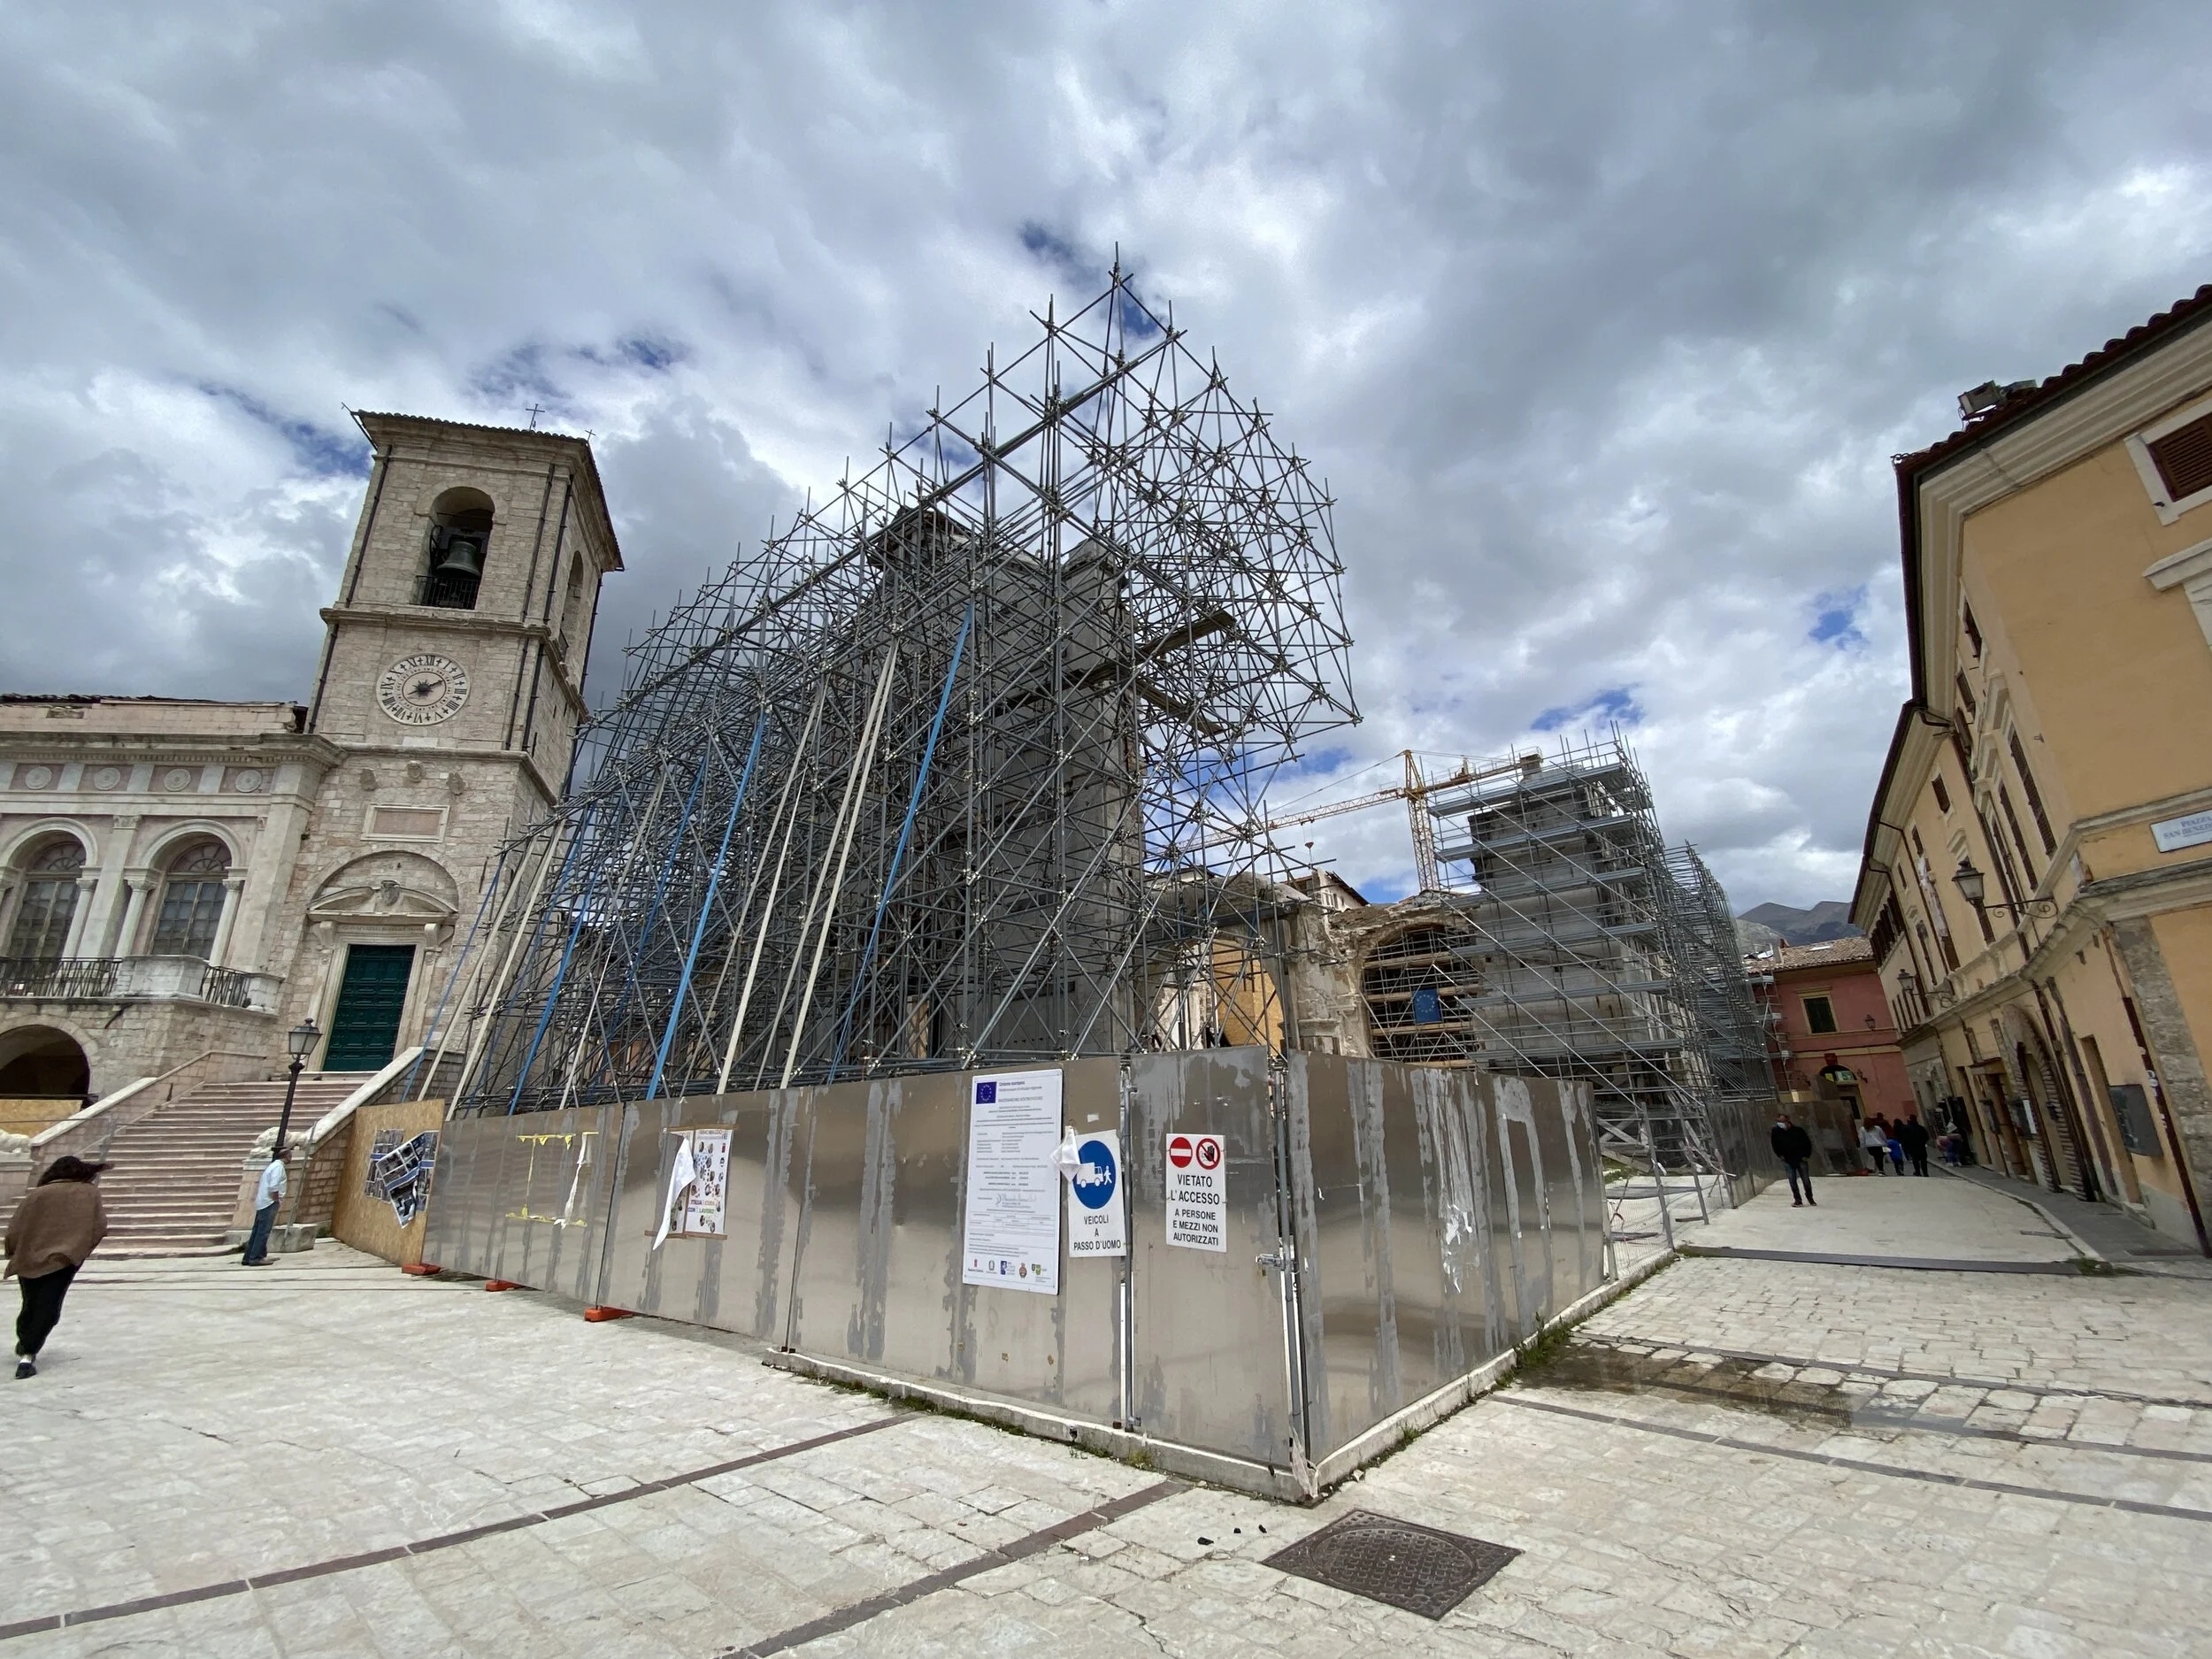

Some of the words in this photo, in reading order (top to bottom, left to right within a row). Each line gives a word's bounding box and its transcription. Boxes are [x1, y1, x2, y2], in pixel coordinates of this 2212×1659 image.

[426, 655, 435, 665] XII
[446, 700, 459, 710] IIII
[413, 713, 423, 723] VI
[1178, 1173, 1212, 1187] VIETATO
[1084, 1214, 1110, 1225] VEICOLI
[1182, 1209, 1216, 1220] PERSONE
[1094, 1228, 1099, 1237] A
[1179, 1221, 1201, 1231] MEZZI
[1202, 1224, 1218, 1233] NON
[1173, 1233, 1218, 1246] AUTORIZZATI
[1073, 1240, 1094, 1251] PASSO
[1095, 1240, 1121, 1250] D'UOMO
